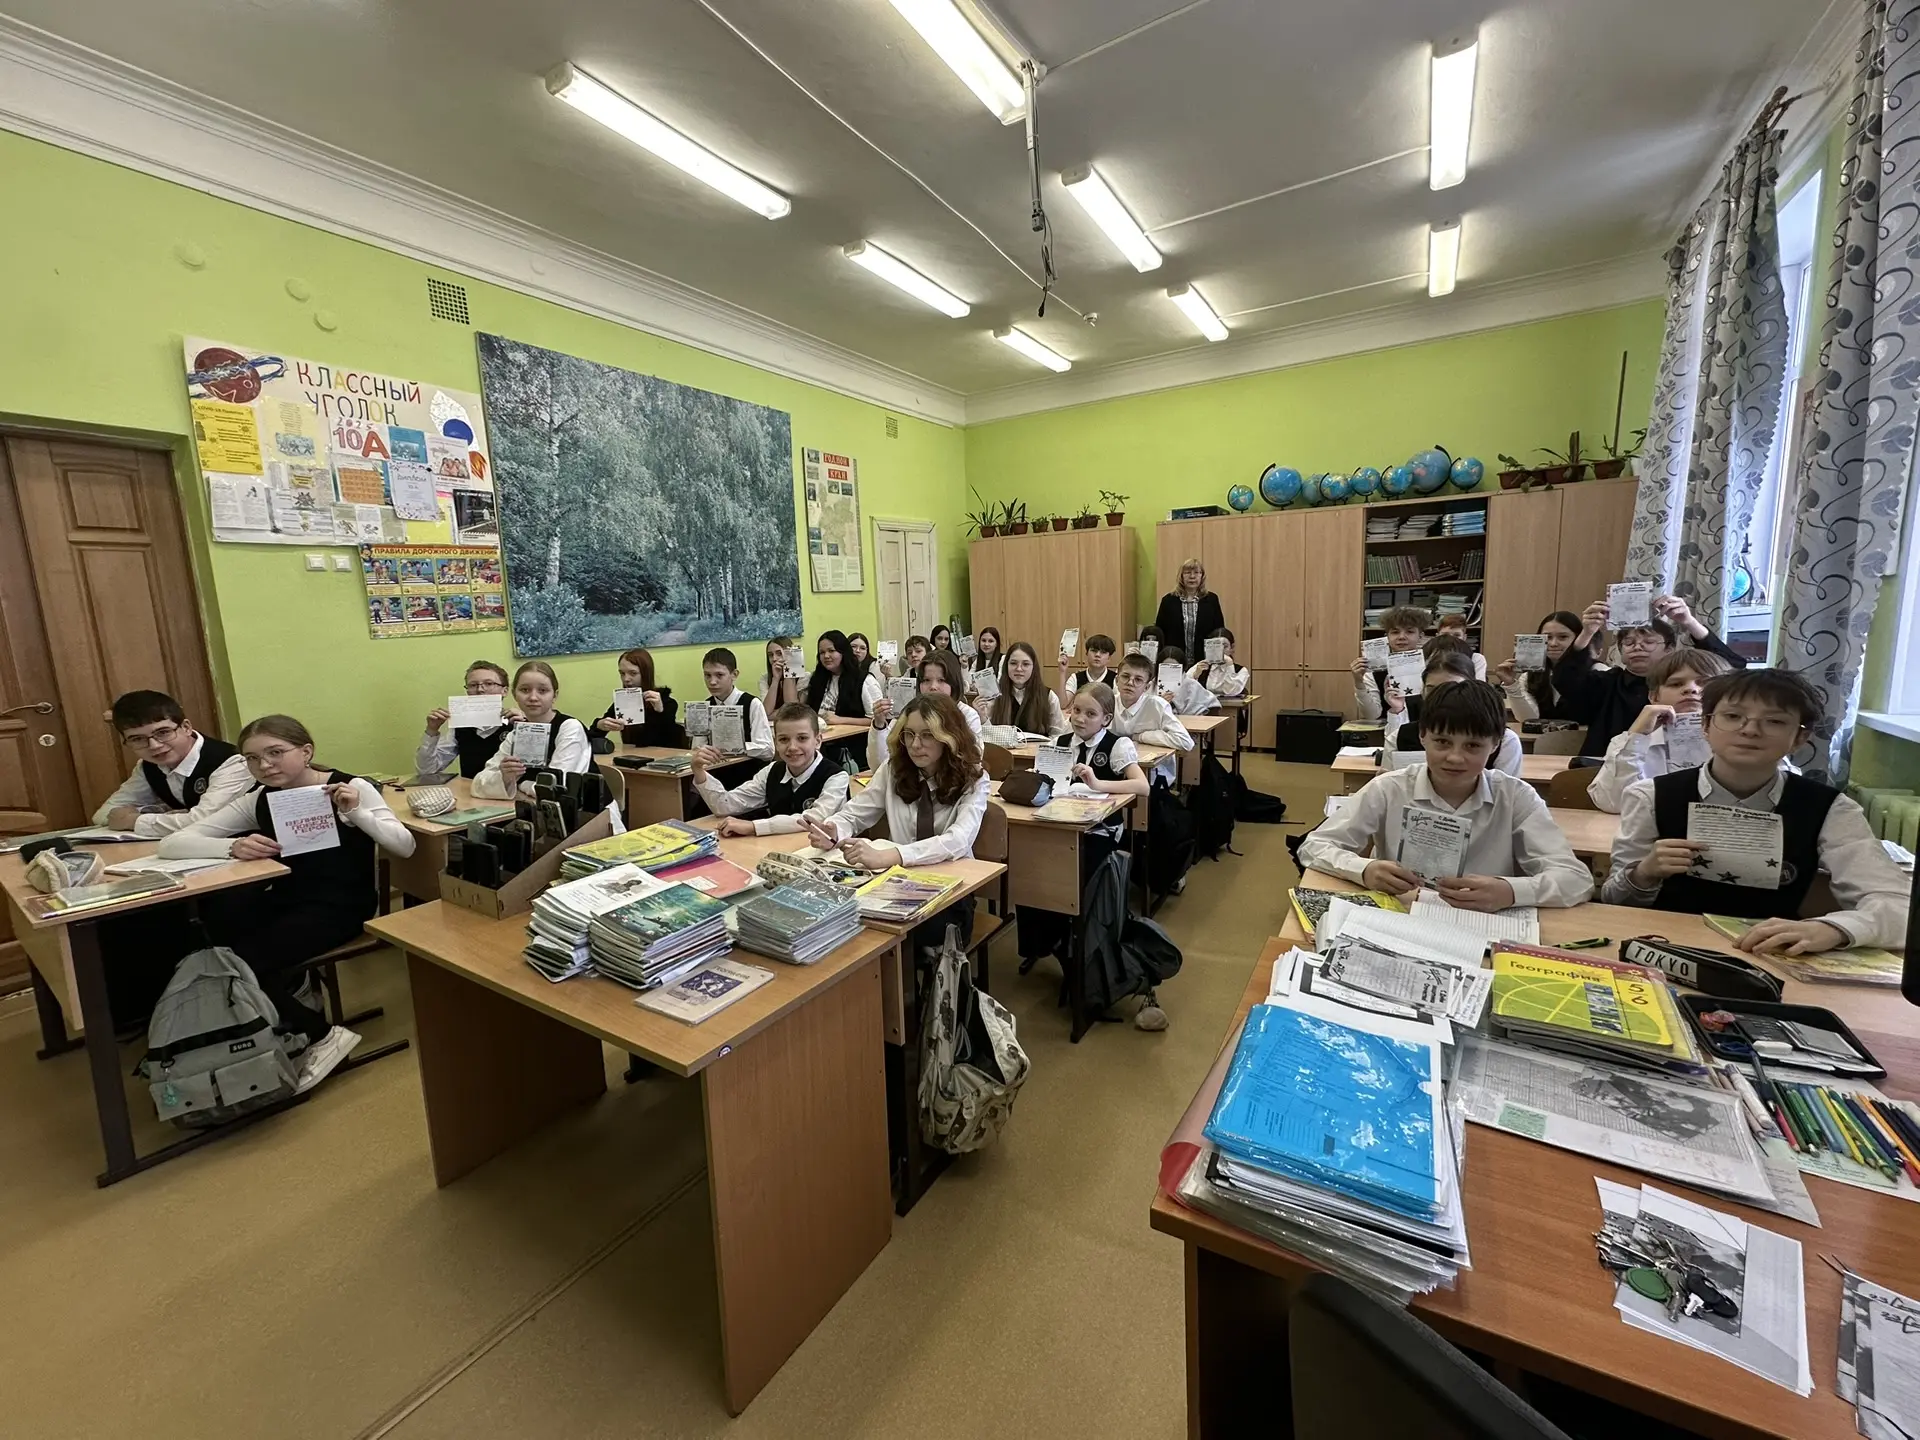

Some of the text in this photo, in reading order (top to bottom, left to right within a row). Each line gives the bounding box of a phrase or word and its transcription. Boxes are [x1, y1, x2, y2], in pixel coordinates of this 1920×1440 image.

[297, 361, 421, 404] КЛАССНЫЙ
[305, 391, 399, 426] УГОЛОК
[412, 548, 459, 556] ДОРОЖНОГО
[1509, 960, 1601, 983] География
[1634, 945, 1689, 976] TOKYO
[1628, 983, 1645, 993] 5
[1631, 995, 1649, 1006] 6
